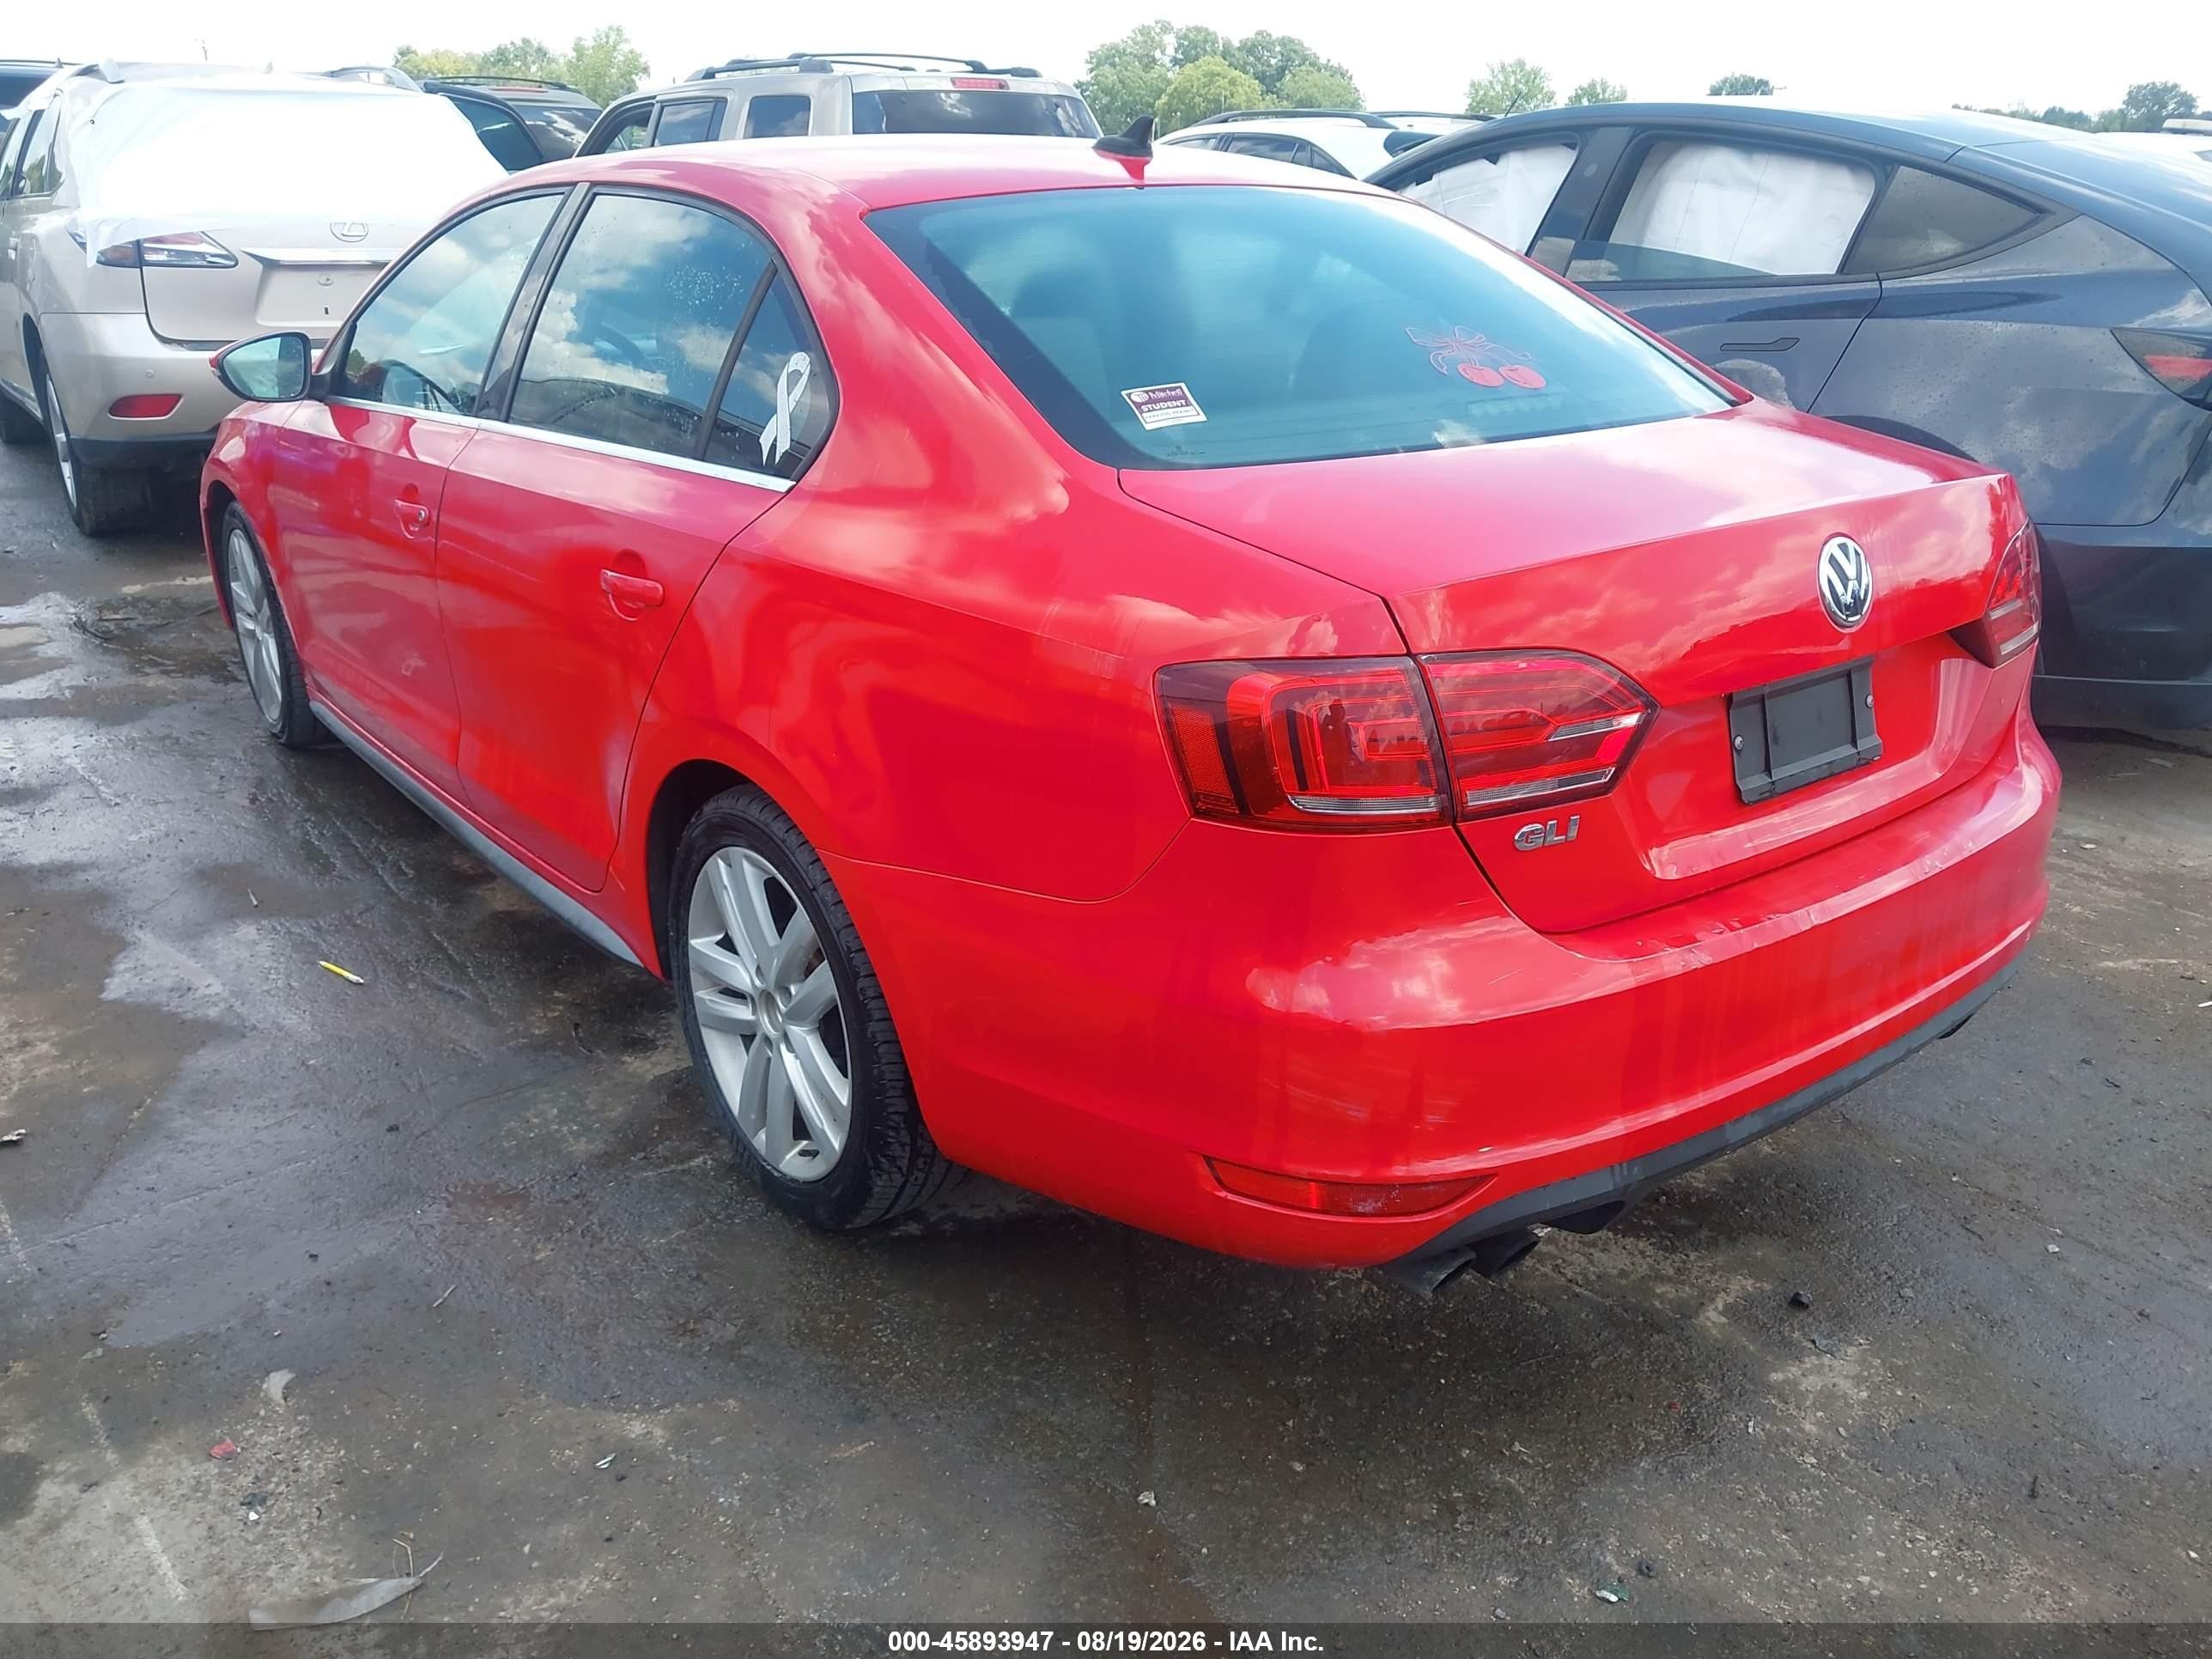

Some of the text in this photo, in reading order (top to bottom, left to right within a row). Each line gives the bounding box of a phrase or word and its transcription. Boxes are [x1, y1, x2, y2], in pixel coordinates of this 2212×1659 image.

[1148, 387, 1183, 399] Mitchell
[1140, 399, 1186, 412] STUDENT
[1514, 815, 1581, 851] GLI
